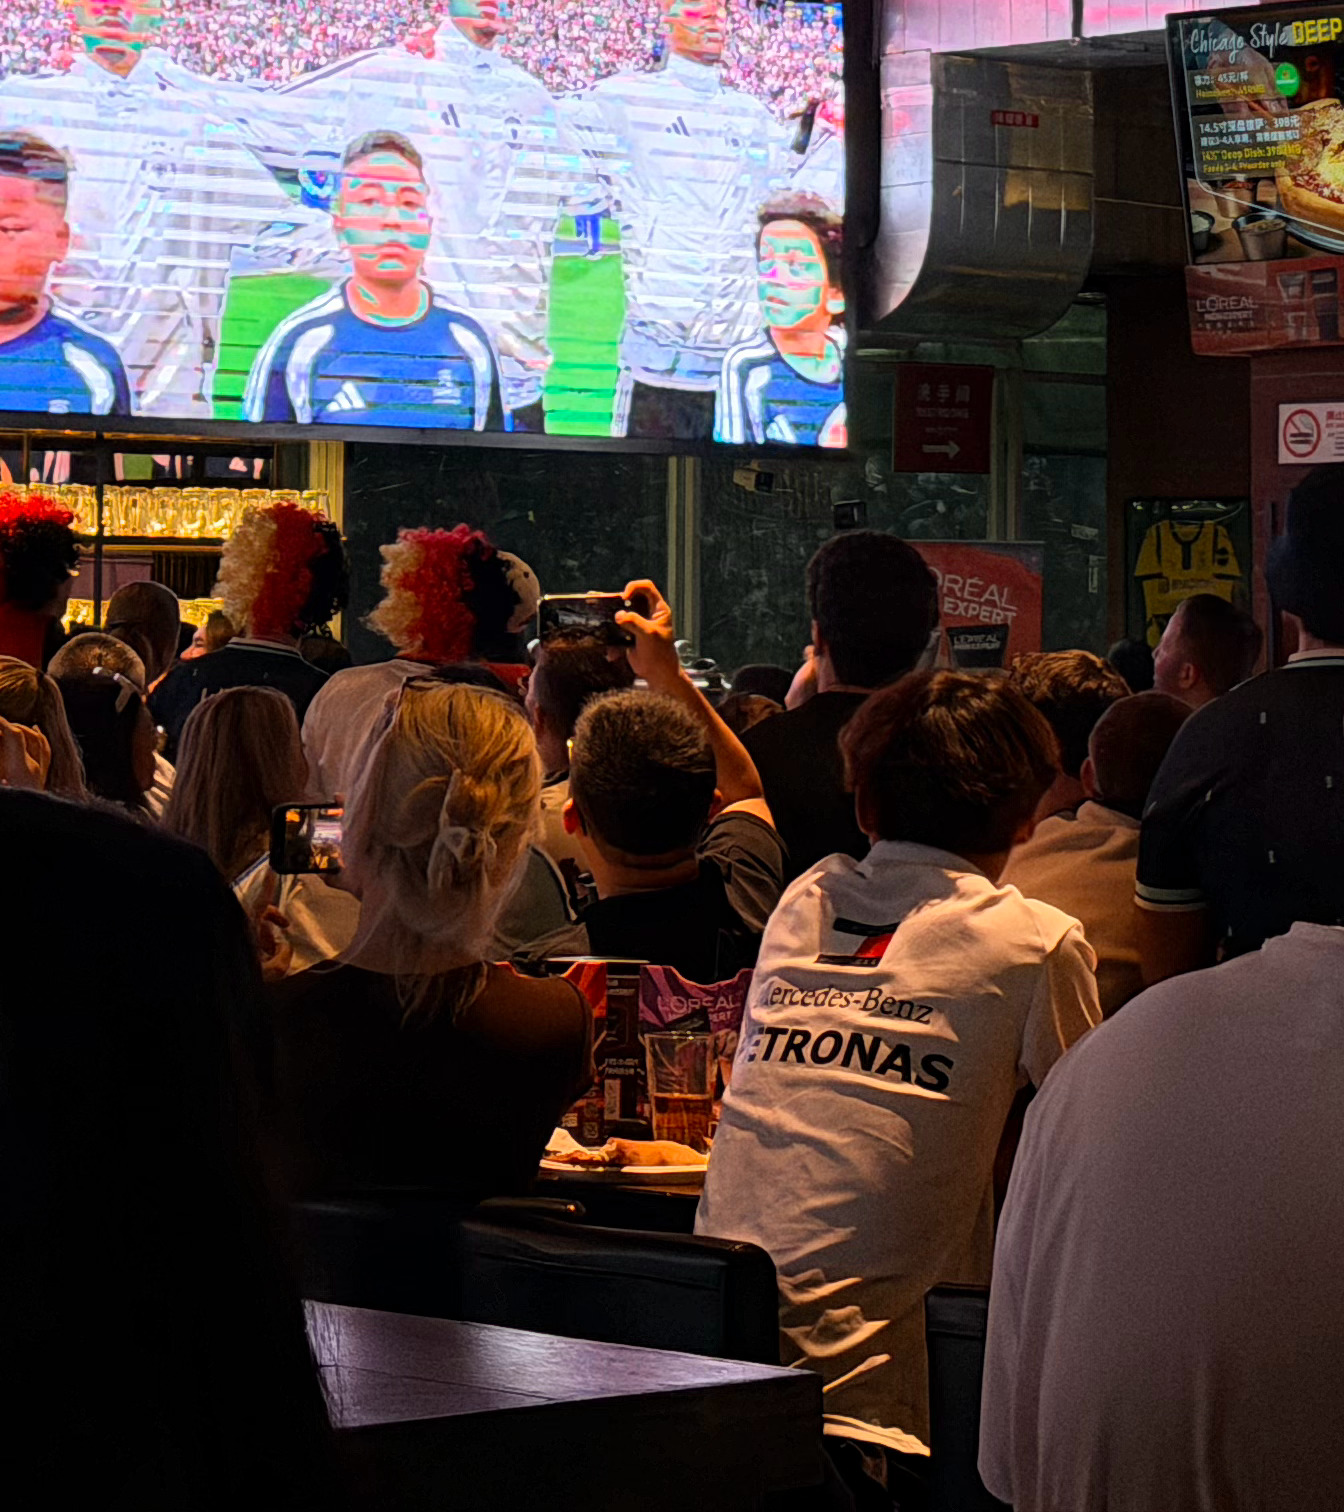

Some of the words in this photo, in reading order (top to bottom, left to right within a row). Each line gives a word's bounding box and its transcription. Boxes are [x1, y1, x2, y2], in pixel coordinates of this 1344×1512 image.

[1190, 29, 1246, 65] Chicago
[1250, 22, 1289, 57] Style
[1291, 17, 1343, 45] DEEP
[943, 596, 1018, 626] EXPERT
